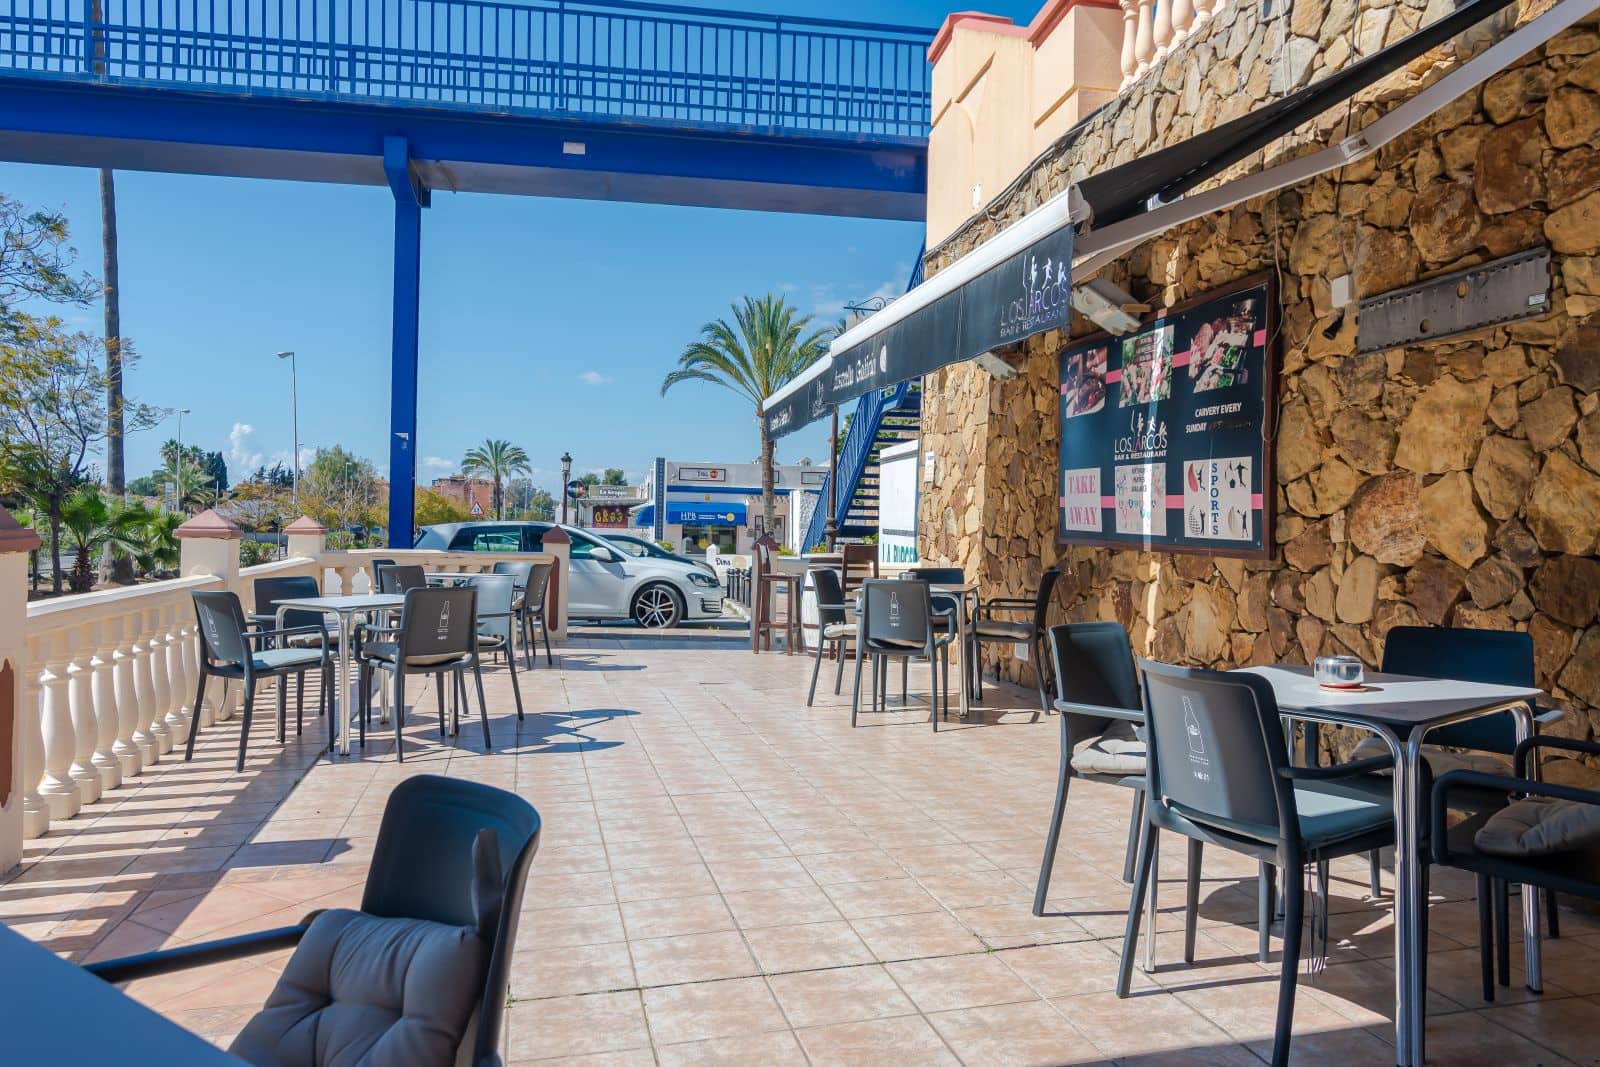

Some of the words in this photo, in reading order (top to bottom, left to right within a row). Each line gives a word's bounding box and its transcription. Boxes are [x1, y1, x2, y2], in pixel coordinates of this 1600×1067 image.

[1001, 298, 1025, 327] LOS
[1194, 404, 1220, 418] CARVERY
[1220, 402, 1242, 415] EVERY
[1185, 421, 1207, 434] SUNDAY
[1114, 436, 1132, 454] LOS
[1135, 432, 1168, 452] ARCOS
[1131, 449, 1167, 459] RESTAURANT
[1069, 475, 1096, 495] TAKE
[1210, 462, 1220, 536] SPORTS
[1069, 506, 1097, 526] AWAY
